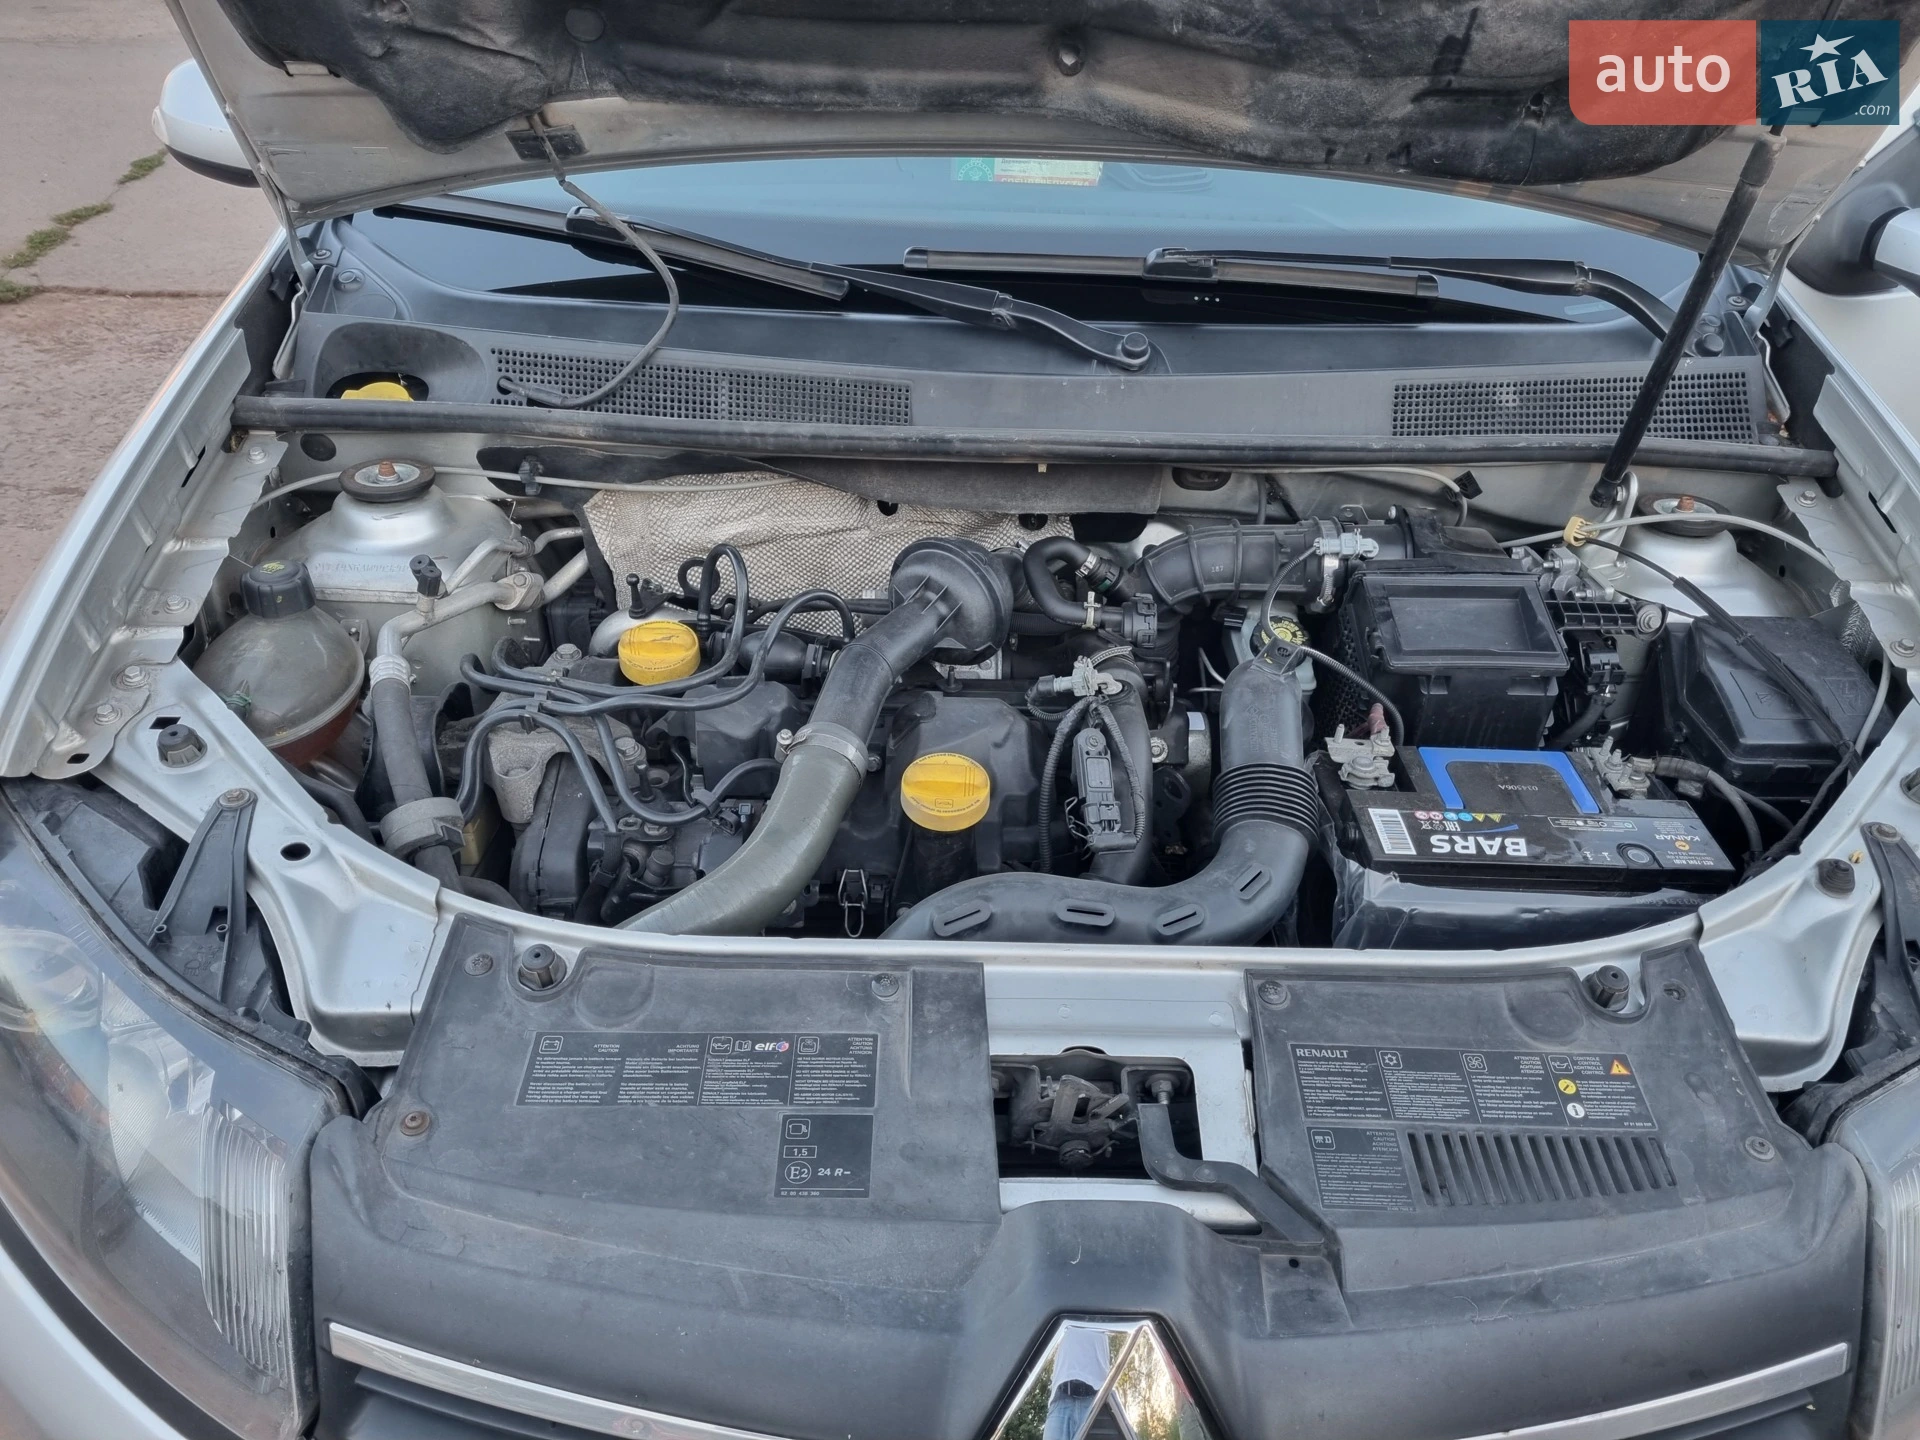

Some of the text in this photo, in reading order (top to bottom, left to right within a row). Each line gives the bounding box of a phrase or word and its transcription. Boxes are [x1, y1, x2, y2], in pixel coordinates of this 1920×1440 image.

[1430, 834, 1527, 856] BARS
[755, 1042, 776, 1050] elf
[1296, 1048, 1348, 1058] RENAULT
[793, 1148, 808, 1157] 1,5
[789, 1166, 808, 1179] E2
